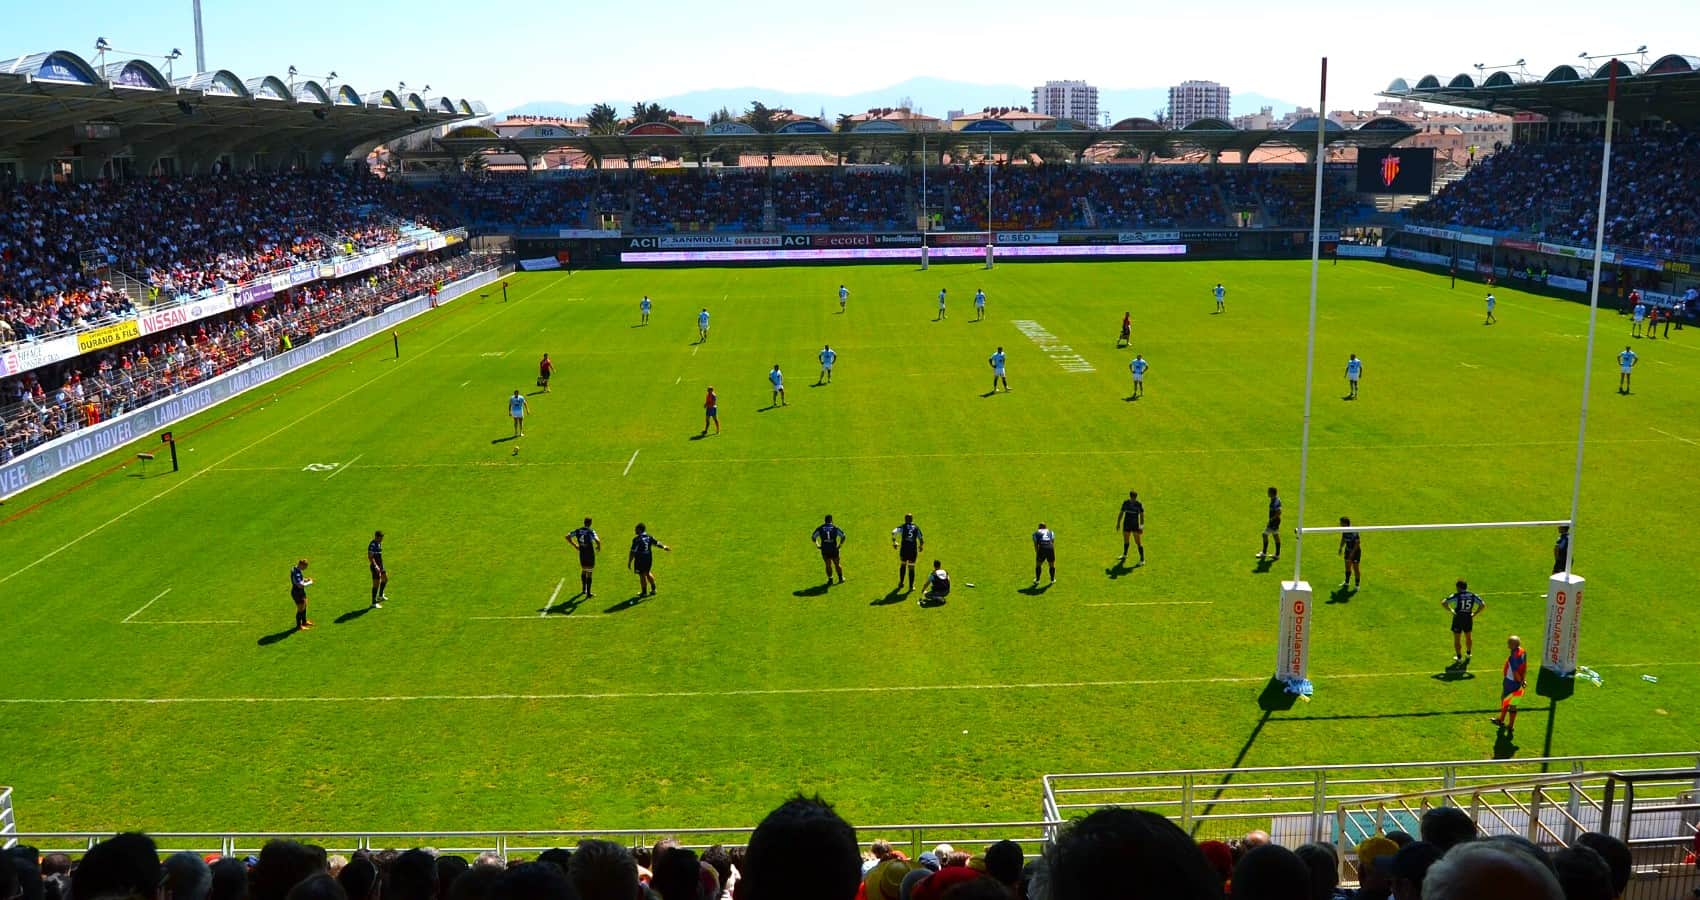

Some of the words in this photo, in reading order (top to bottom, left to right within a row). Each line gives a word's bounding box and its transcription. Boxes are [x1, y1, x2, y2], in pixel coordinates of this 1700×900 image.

[630, 238, 656, 248] ACI
[672, 236, 731, 244] SANMIQUEL
[784, 236, 810, 246] ACI
[831, 235, 869, 246] ecotel
[143, 308, 187, 332] NISSAN
[80, 334, 114, 350] DURAND
[115, 333, 121, 341] &
[122, 327, 138, 340] FILS
[228, 374, 250, 393] LAND
[250, 363, 274, 384] ROVER
[154, 402, 180, 425] LAND
[182, 388, 212, 410] ROVER
[58, 440, 93, 467] LAND
[95, 421, 132, 450] ROVER
[1460, 599, 1472, 610] 15
[1292, 616, 1304, 675] boulanger
[1551, 606, 1564, 665] boulanger
